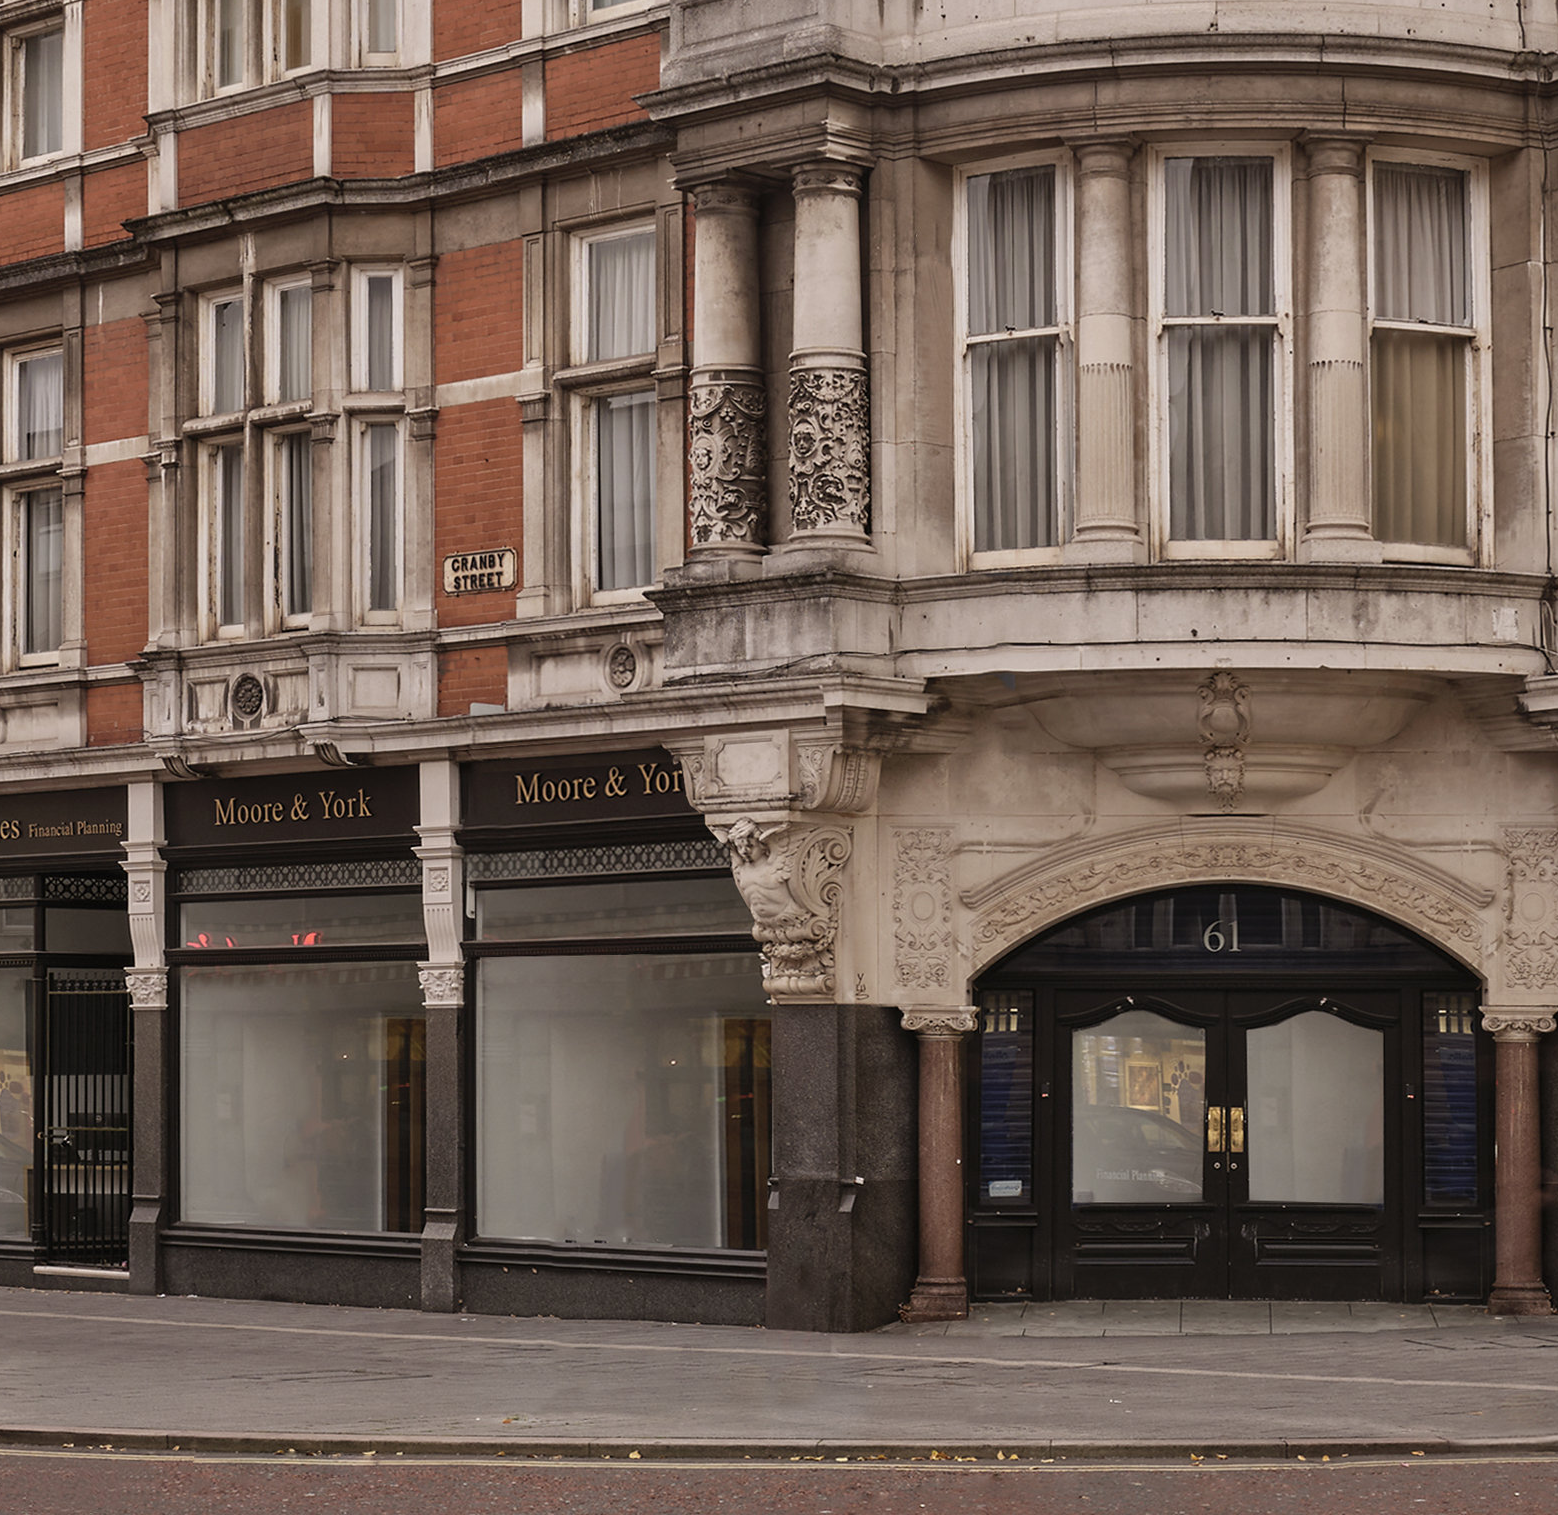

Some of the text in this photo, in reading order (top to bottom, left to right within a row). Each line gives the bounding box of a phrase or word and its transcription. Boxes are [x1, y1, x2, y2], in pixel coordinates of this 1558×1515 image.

[454, 571, 504, 590] STREET
[515, 763, 682, 804] Moore & Yor
[214, 788, 372, 825] Moore & York
[29, 822, 73, 838] Financial
[77, 819, 123, 836] Planning
[1203, 920, 1241, 952] 61
